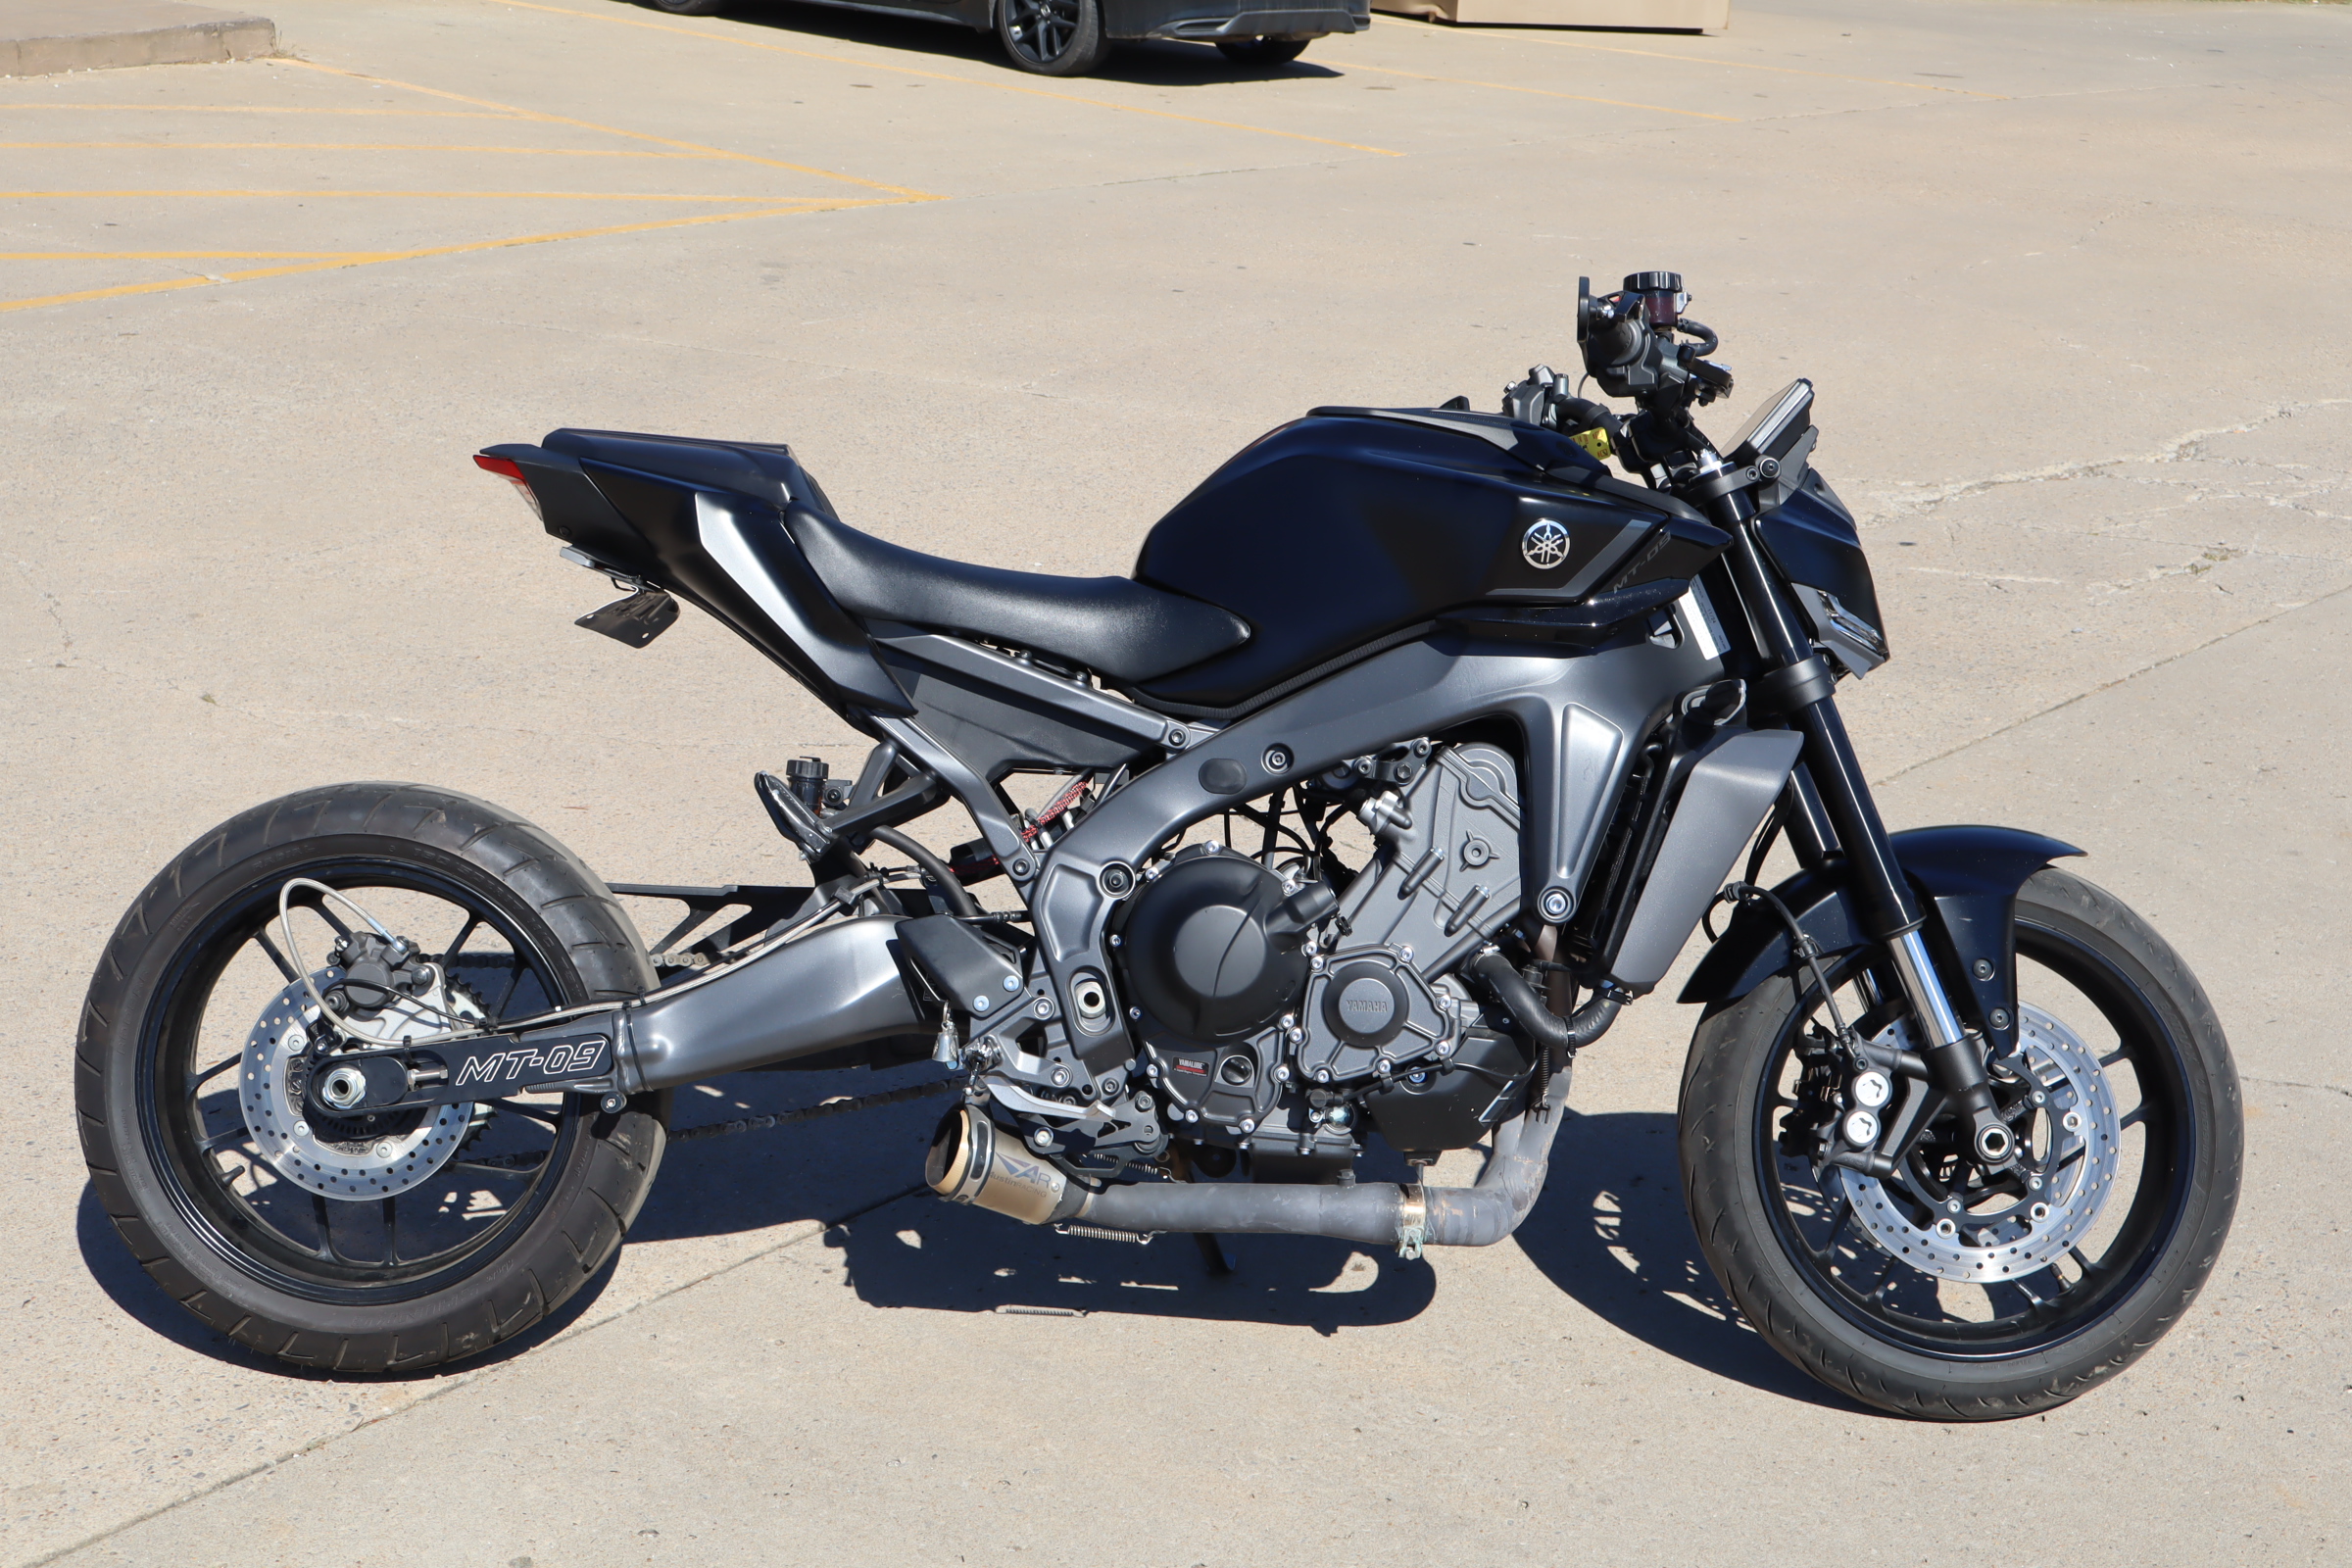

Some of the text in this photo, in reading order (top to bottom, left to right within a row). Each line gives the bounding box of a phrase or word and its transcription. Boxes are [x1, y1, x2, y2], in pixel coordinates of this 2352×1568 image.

[1613, 530, 1672, 595] MT-09
[1346, 1000, 1388, 1013] YAMAHA
[456, 1040, 607, 1086] MT-09
[1178, 1058, 1204, 1070] YAMALUBE
[1014, 1165, 1052, 1189] AR
